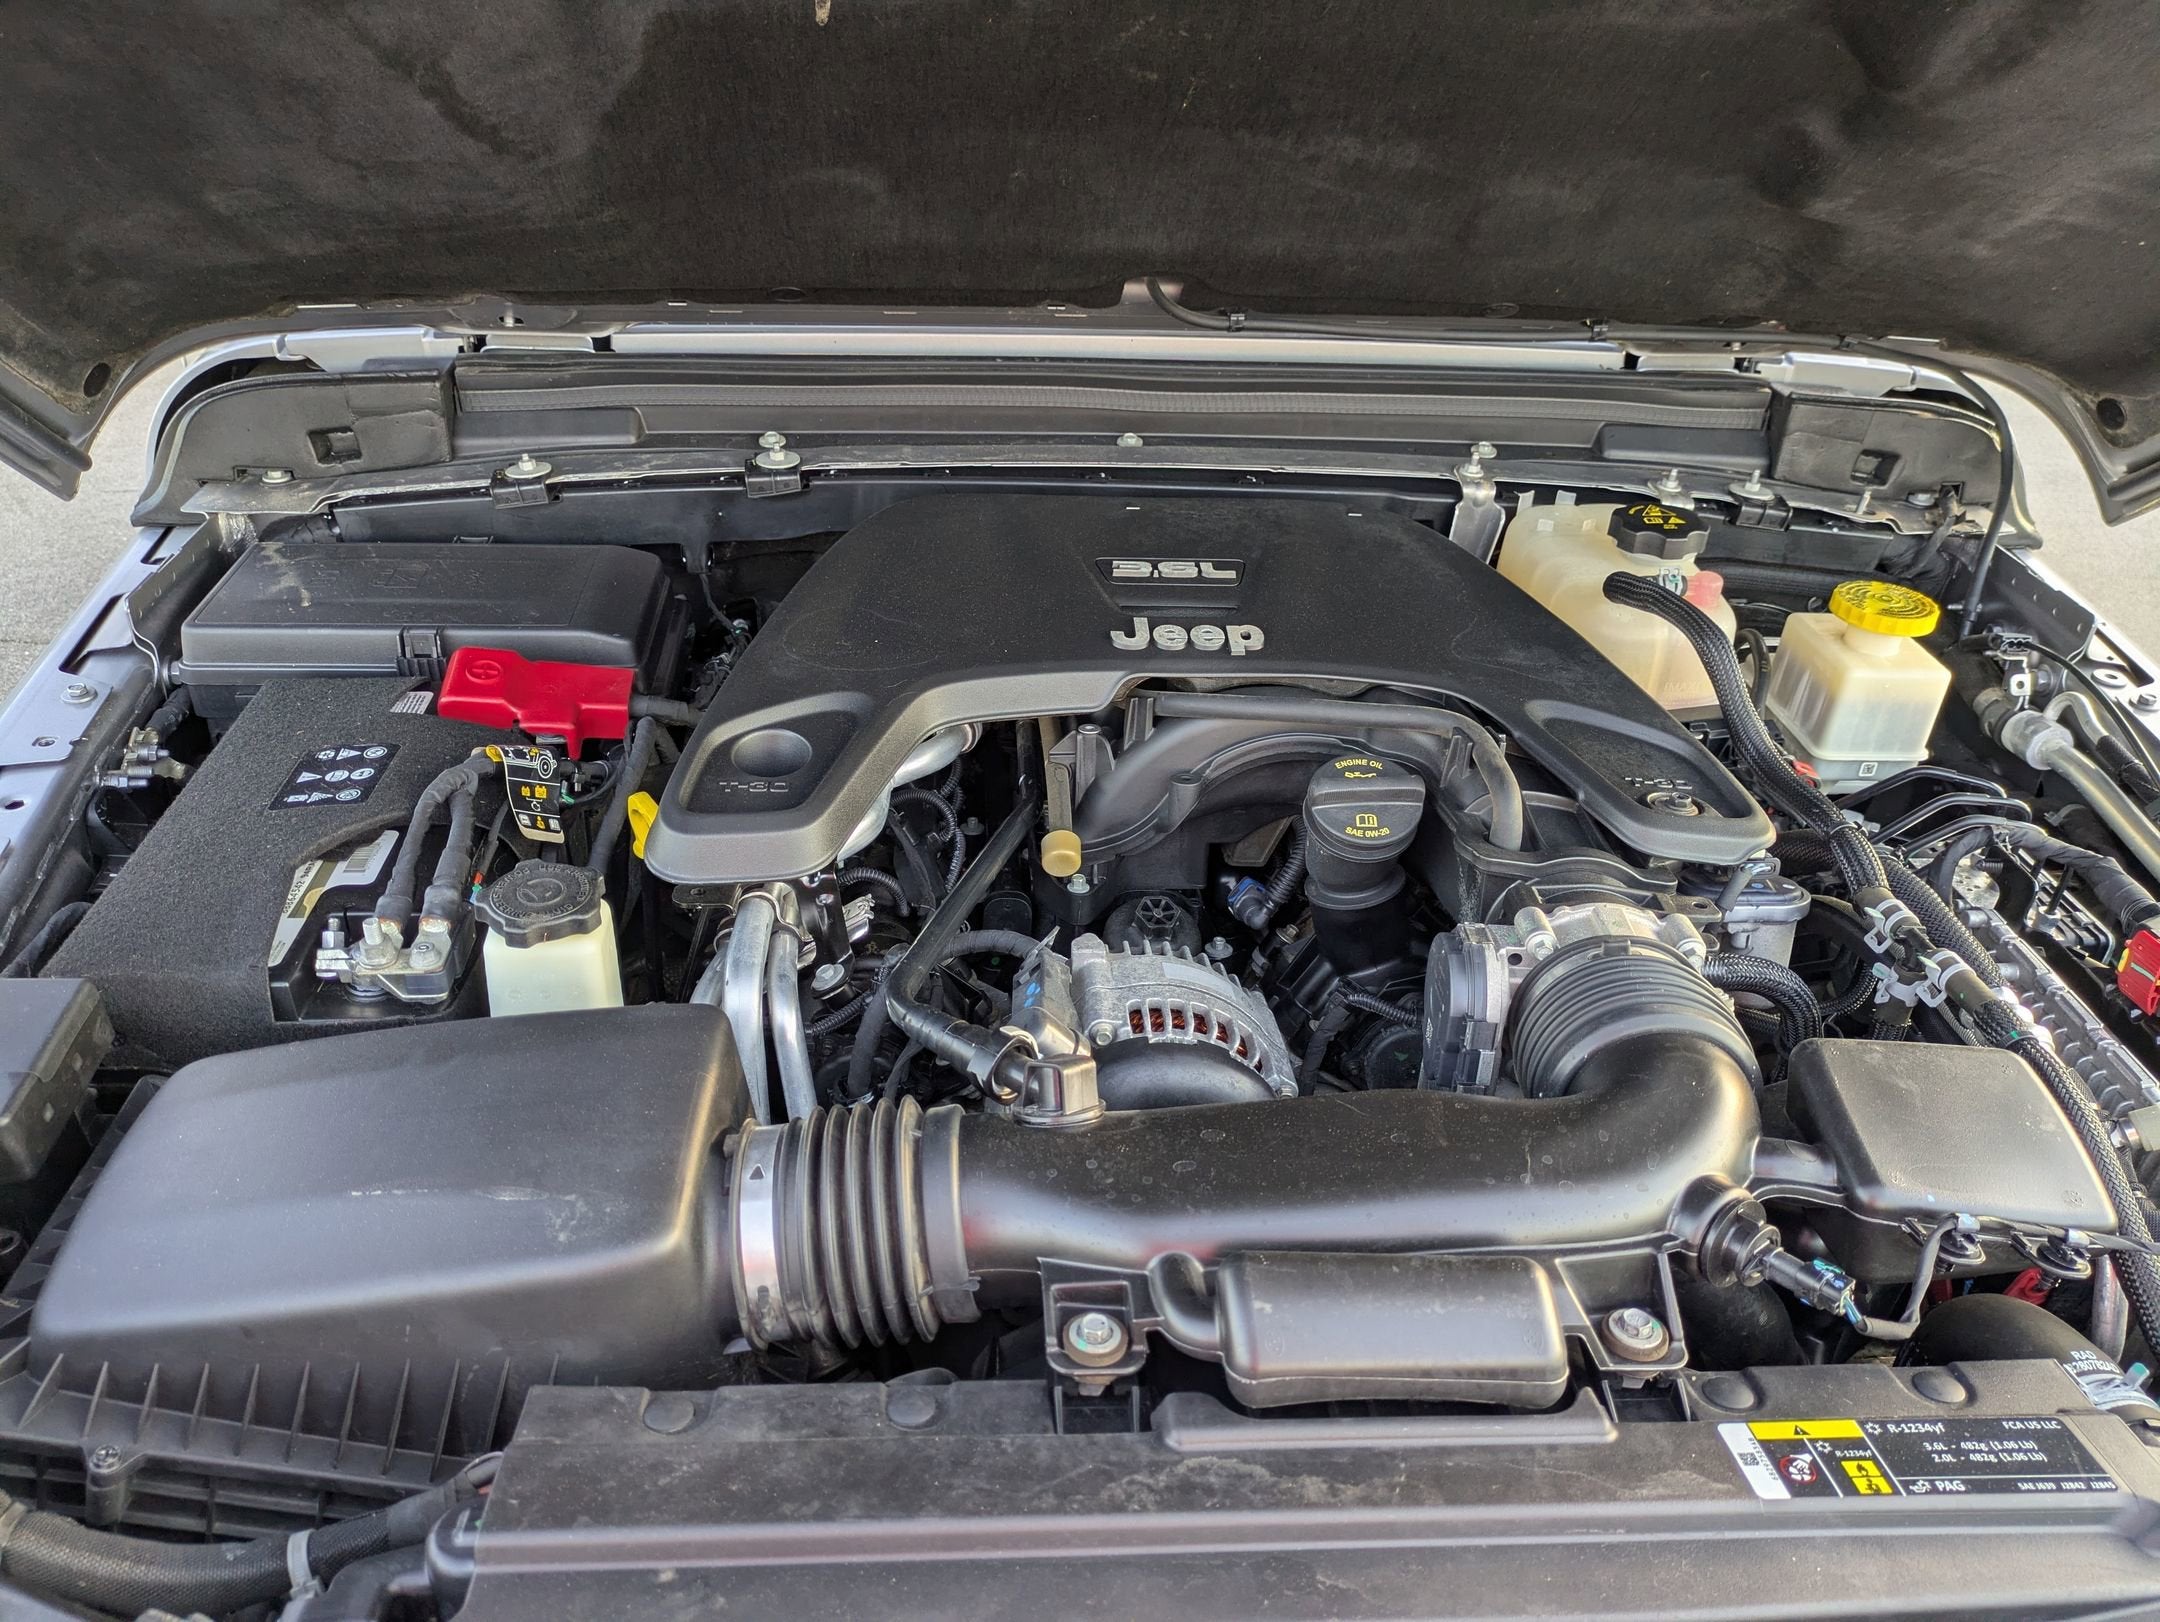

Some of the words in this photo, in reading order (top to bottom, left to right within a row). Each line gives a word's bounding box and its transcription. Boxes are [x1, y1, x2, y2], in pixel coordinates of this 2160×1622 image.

[1112, 560, 1238, 579] 3.6L
[1110, 617, 1265, 656] Jeep
[1334, 759, 1368, 770] ENGINE
[1369, 759, 1384, 770] OIL
[1344, 826, 1365, 838] SAE
[1364, 826, 1391, 838] 0W-20
[2070, 1350, 2097, 1361] RAD
[1886, 1422, 1946, 1435] R-1234yf
[2002, 1421, 2026, 1431] FCA
[2026, 1420, 2042, 1430] US
[2042, 1420, 2062, 1430] LLC
[1923, 1442, 1949, 1451] 3.6L
[1960, 1441, 1989, 1451] 482g
[1989, 1440, 2019, 1451] (1.06
[1931, 1453, 1958, 1463] 2.0L
[1969, 1453, 1998, 1463] 482g
[1935, 1480, 1967, 1492] PAG
[2017, 1481, 2037, 1490] SAE
